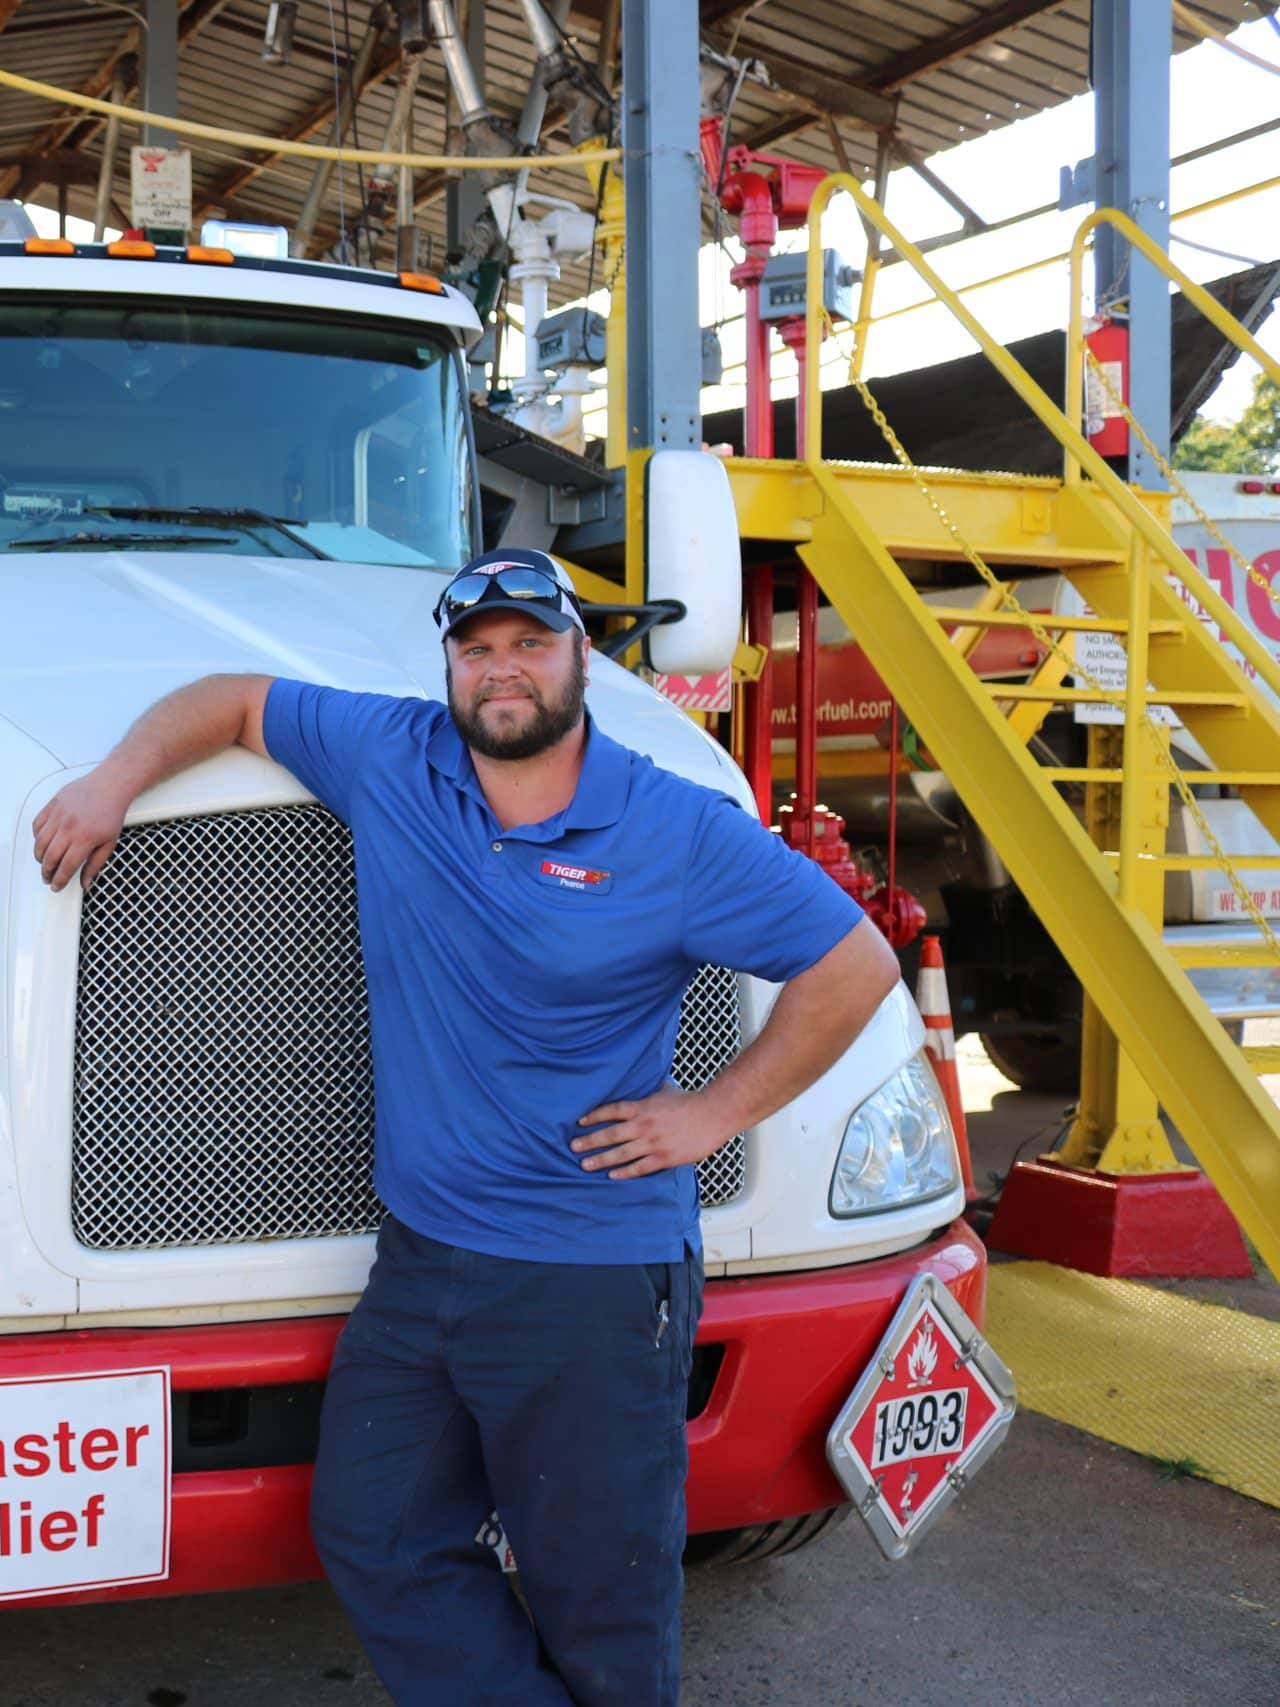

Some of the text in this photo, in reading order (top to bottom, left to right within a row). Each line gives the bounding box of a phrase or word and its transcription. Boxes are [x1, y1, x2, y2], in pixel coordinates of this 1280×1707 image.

[551, 864, 586, 880] TIGER
[1220, 892, 1235, 911] WE
[878, 1391, 963, 1461] 1993
